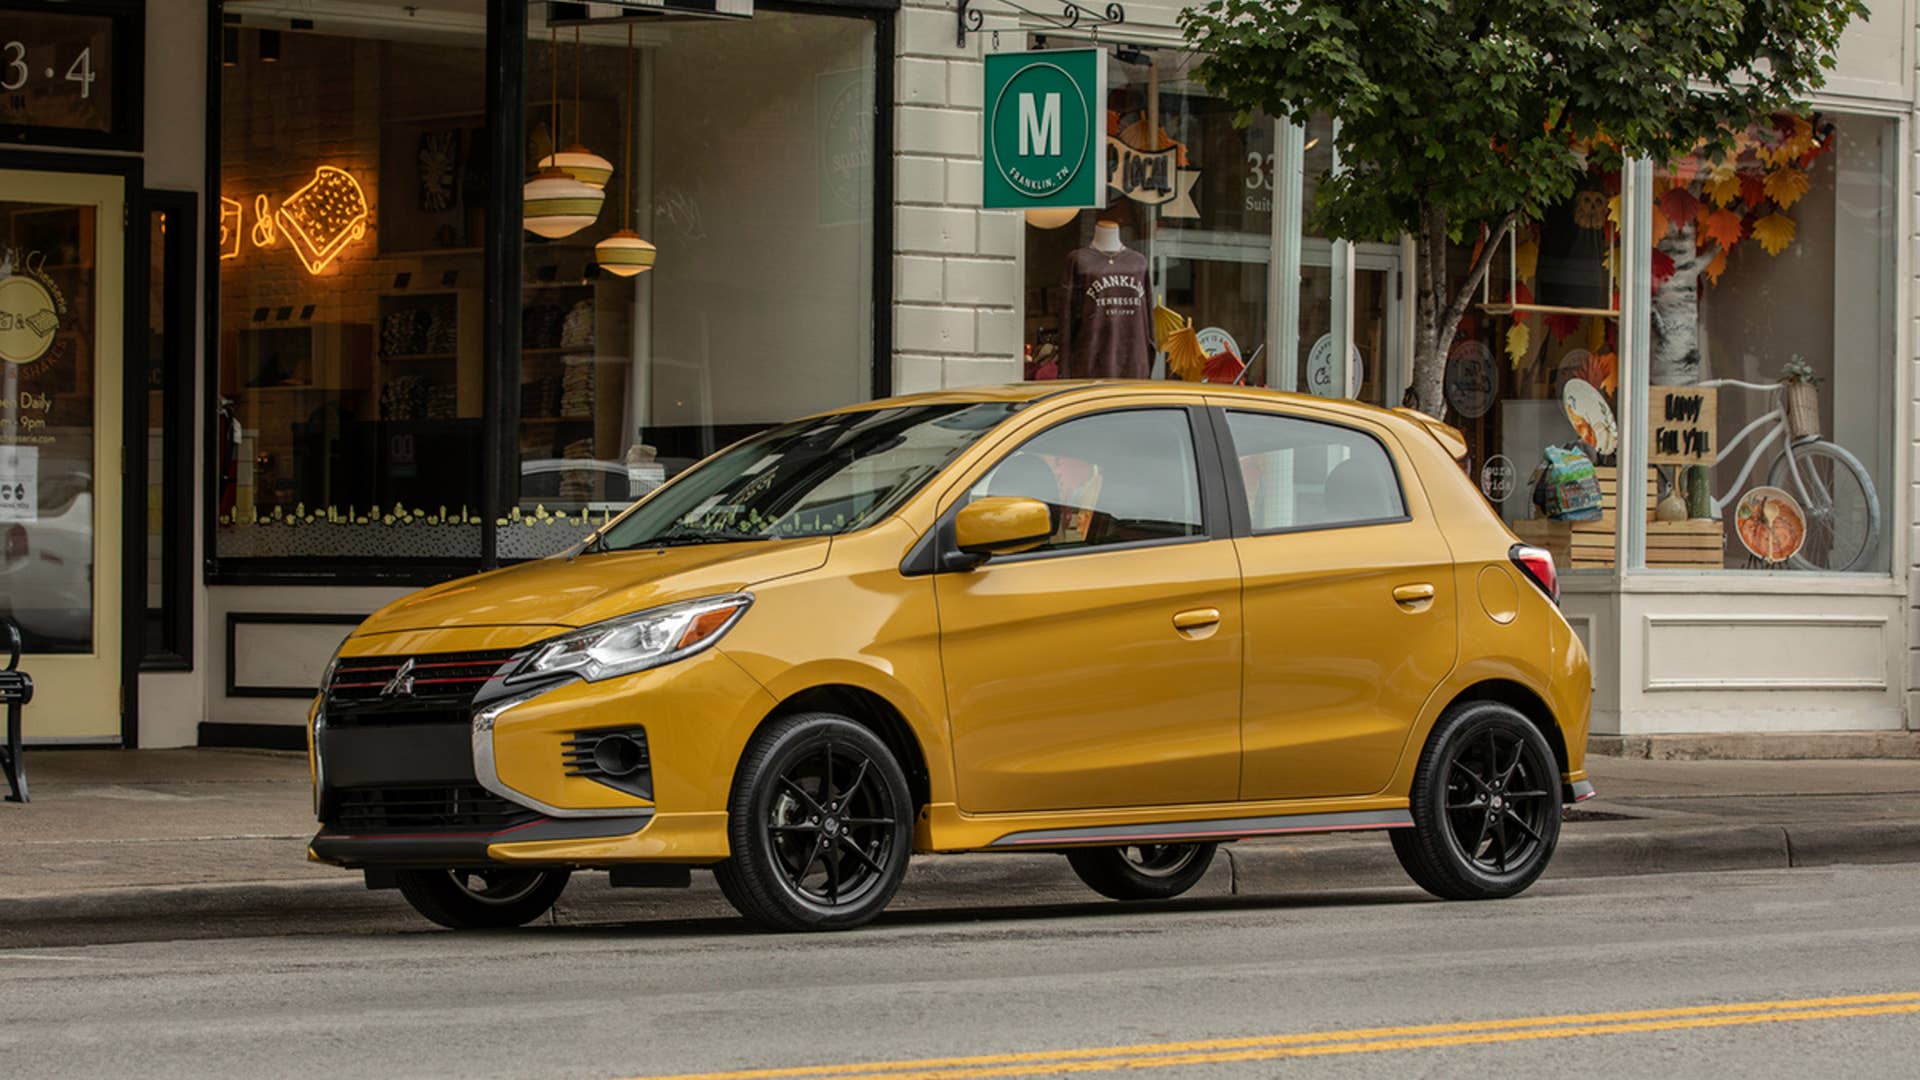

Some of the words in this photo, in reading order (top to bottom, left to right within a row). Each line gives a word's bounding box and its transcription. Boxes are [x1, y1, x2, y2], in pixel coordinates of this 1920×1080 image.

[1019, 93, 1060, 156] M
[1009, 167, 1056, 190] FRANKLIN,
[1056, 166, 1069, 180] TN
[1122, 150, 1172, 197] LOCAL
[1246, 196, 1273, 213] Suit
[20, 391, 52, 413] Daily
[1665, 393, 1704, 423] HAPPY
[20, 415, 46, 432] 9pm
[1656, 426, 1680, 456] FALL
[1485, 466, 1512, 479] pura
[1485, 479, 1511, 491] vida
